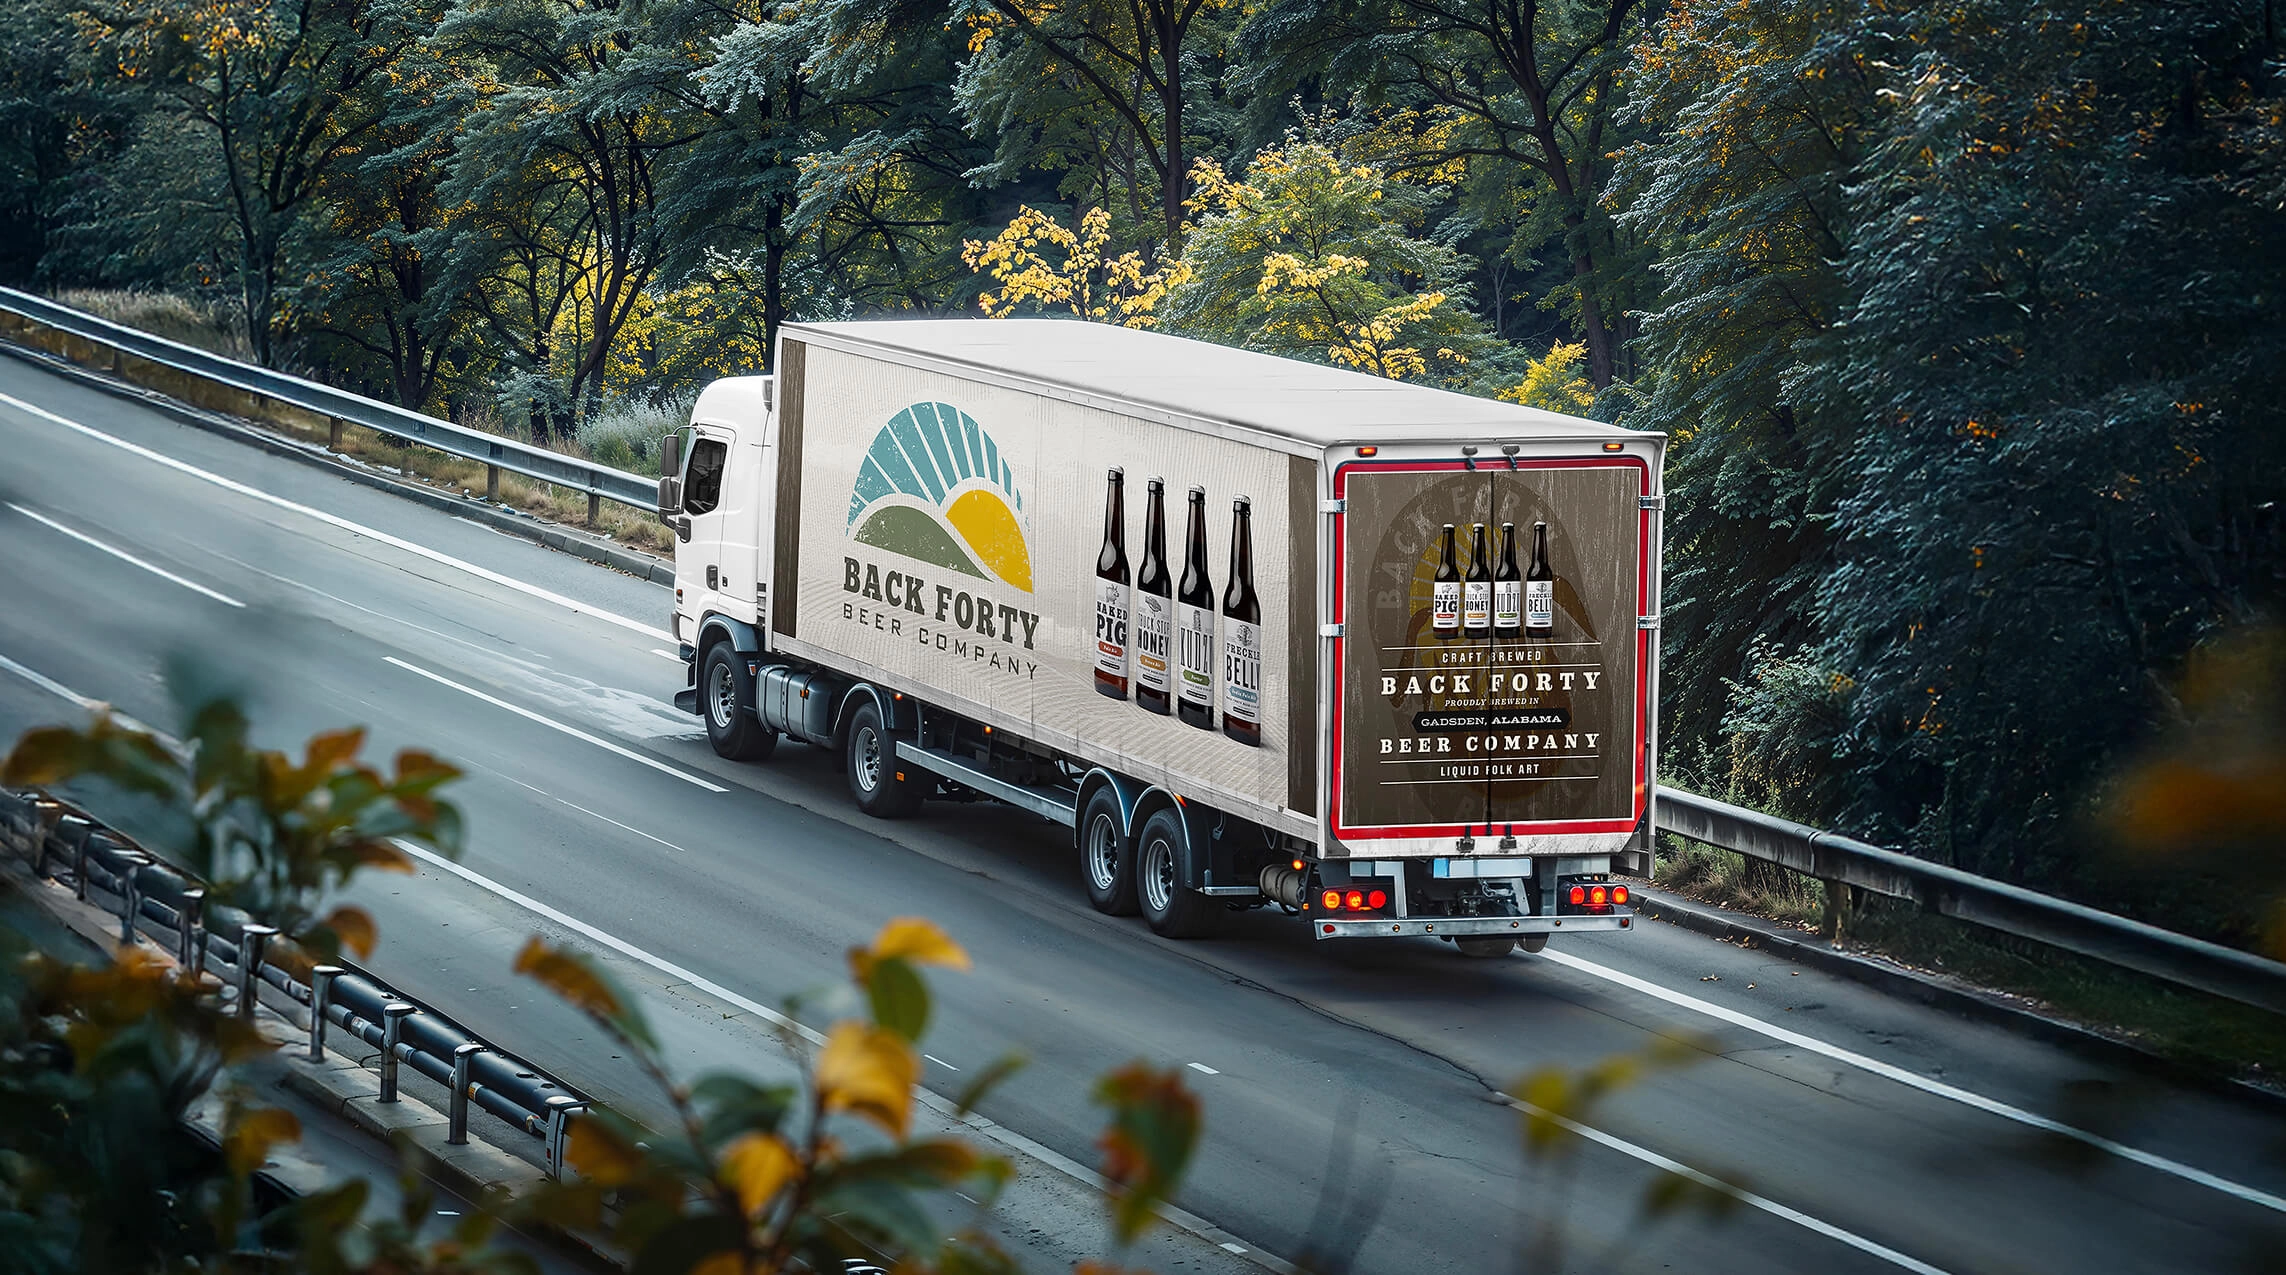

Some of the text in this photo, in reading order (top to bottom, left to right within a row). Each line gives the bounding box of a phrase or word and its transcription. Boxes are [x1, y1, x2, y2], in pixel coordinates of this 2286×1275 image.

[843, 556, 1039, 650] BACK FORTY
[1096, 601, 1128, 620] NAKED
[1435, 600, 1457, 612] PIG
[1096, 612, 1127, 647] PIG
[843, 603, 1038, 680] BEER COMPANY
[1137, 628, 1170, 657] HONEY
[1442, 651, 1542, 663] CRAFT BREWED
[1381, 672, 1600, 695] BACK FORTY
[1444, 698, 1487, 707] PROUDLY
[1529, 697, 1540, 705] IN
[1420, 715, 1562, 727] GADSDEN, ALABAMA
[1380, 733, 1600, 754] BEER COMPANY
[1440, 763, 1540, 778] LIQUID FOLK ART
